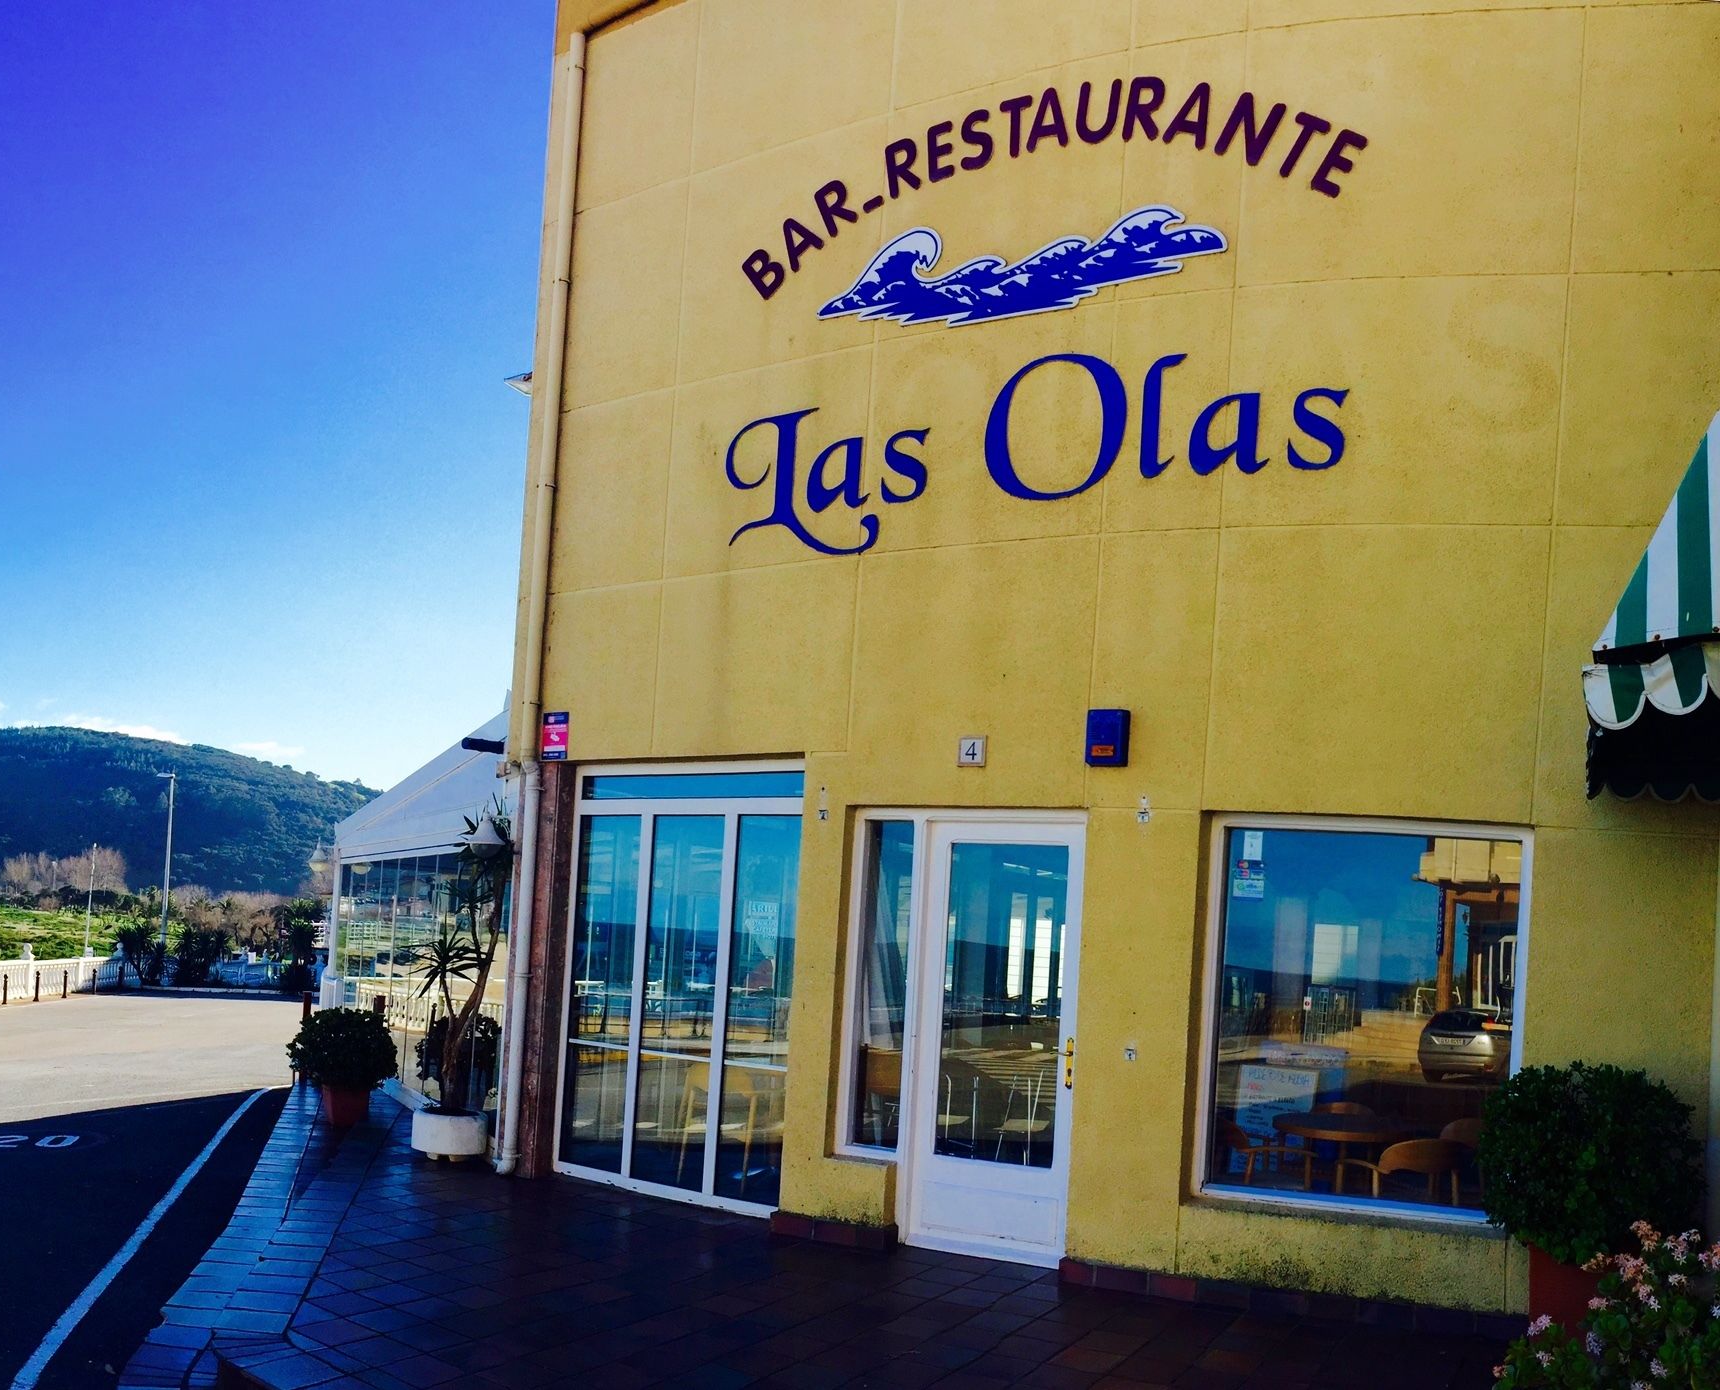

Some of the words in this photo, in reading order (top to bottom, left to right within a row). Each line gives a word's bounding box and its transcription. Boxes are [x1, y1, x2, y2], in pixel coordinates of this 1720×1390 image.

[726, 408, 931, 556] Las
[984, 353, 1350, 501] Olas
[964, 741, 978, 761] 4
